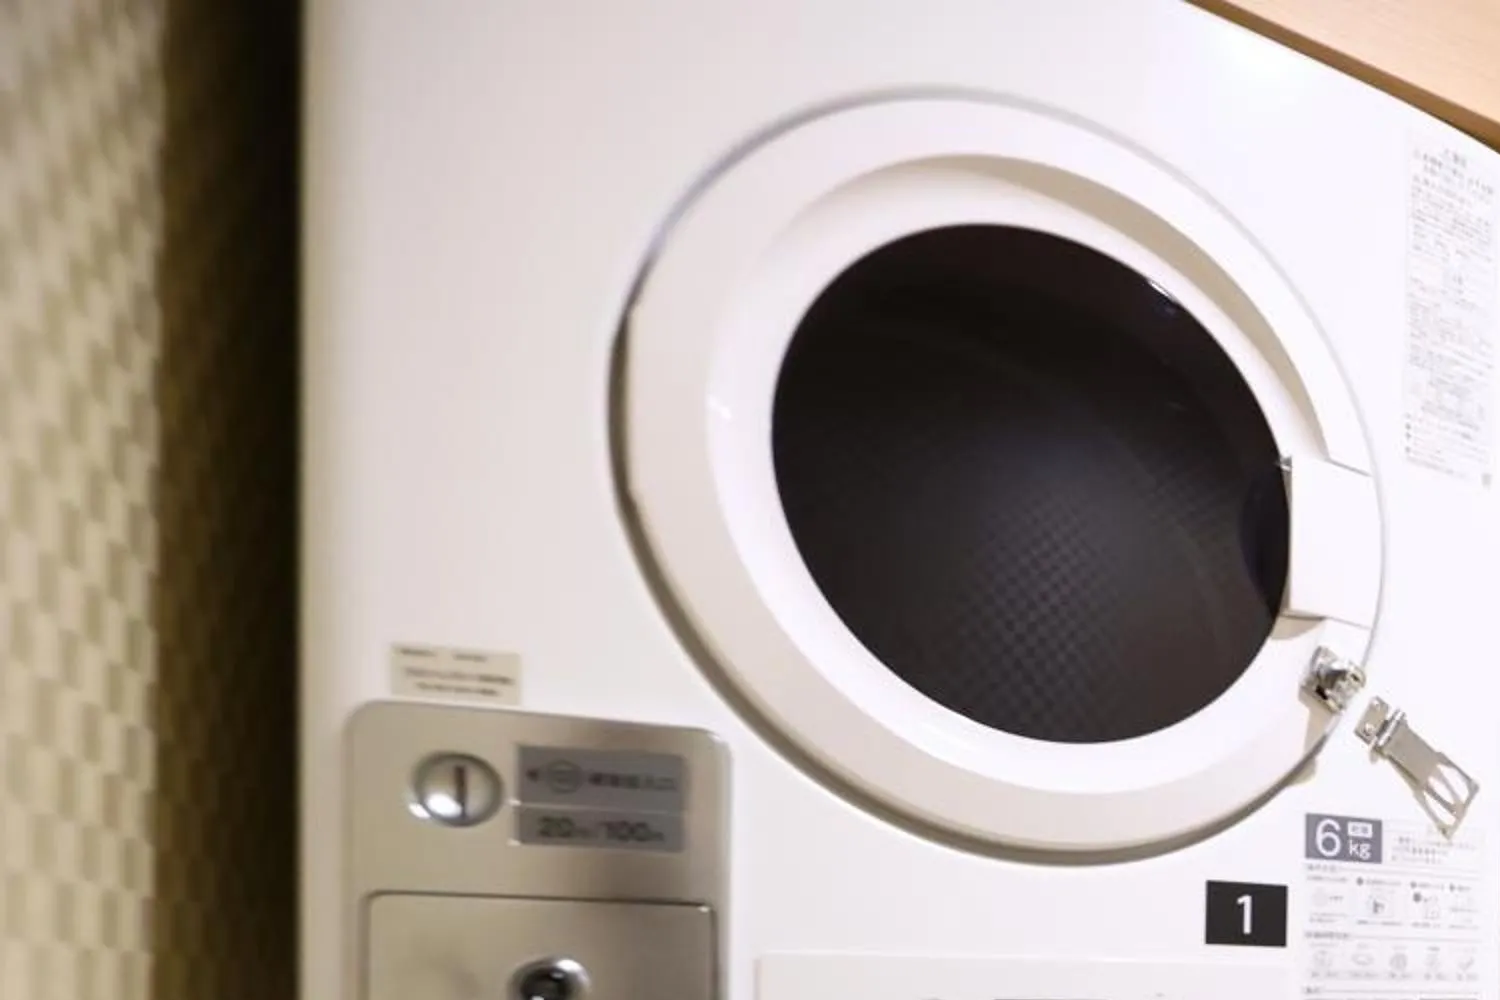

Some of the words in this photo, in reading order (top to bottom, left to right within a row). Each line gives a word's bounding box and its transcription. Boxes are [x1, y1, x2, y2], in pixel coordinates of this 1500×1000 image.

[1316, 818, 1341, 857] 6
[1348, 838, 1372, 860] kg
[1237, 894, 1252, 935] 1
